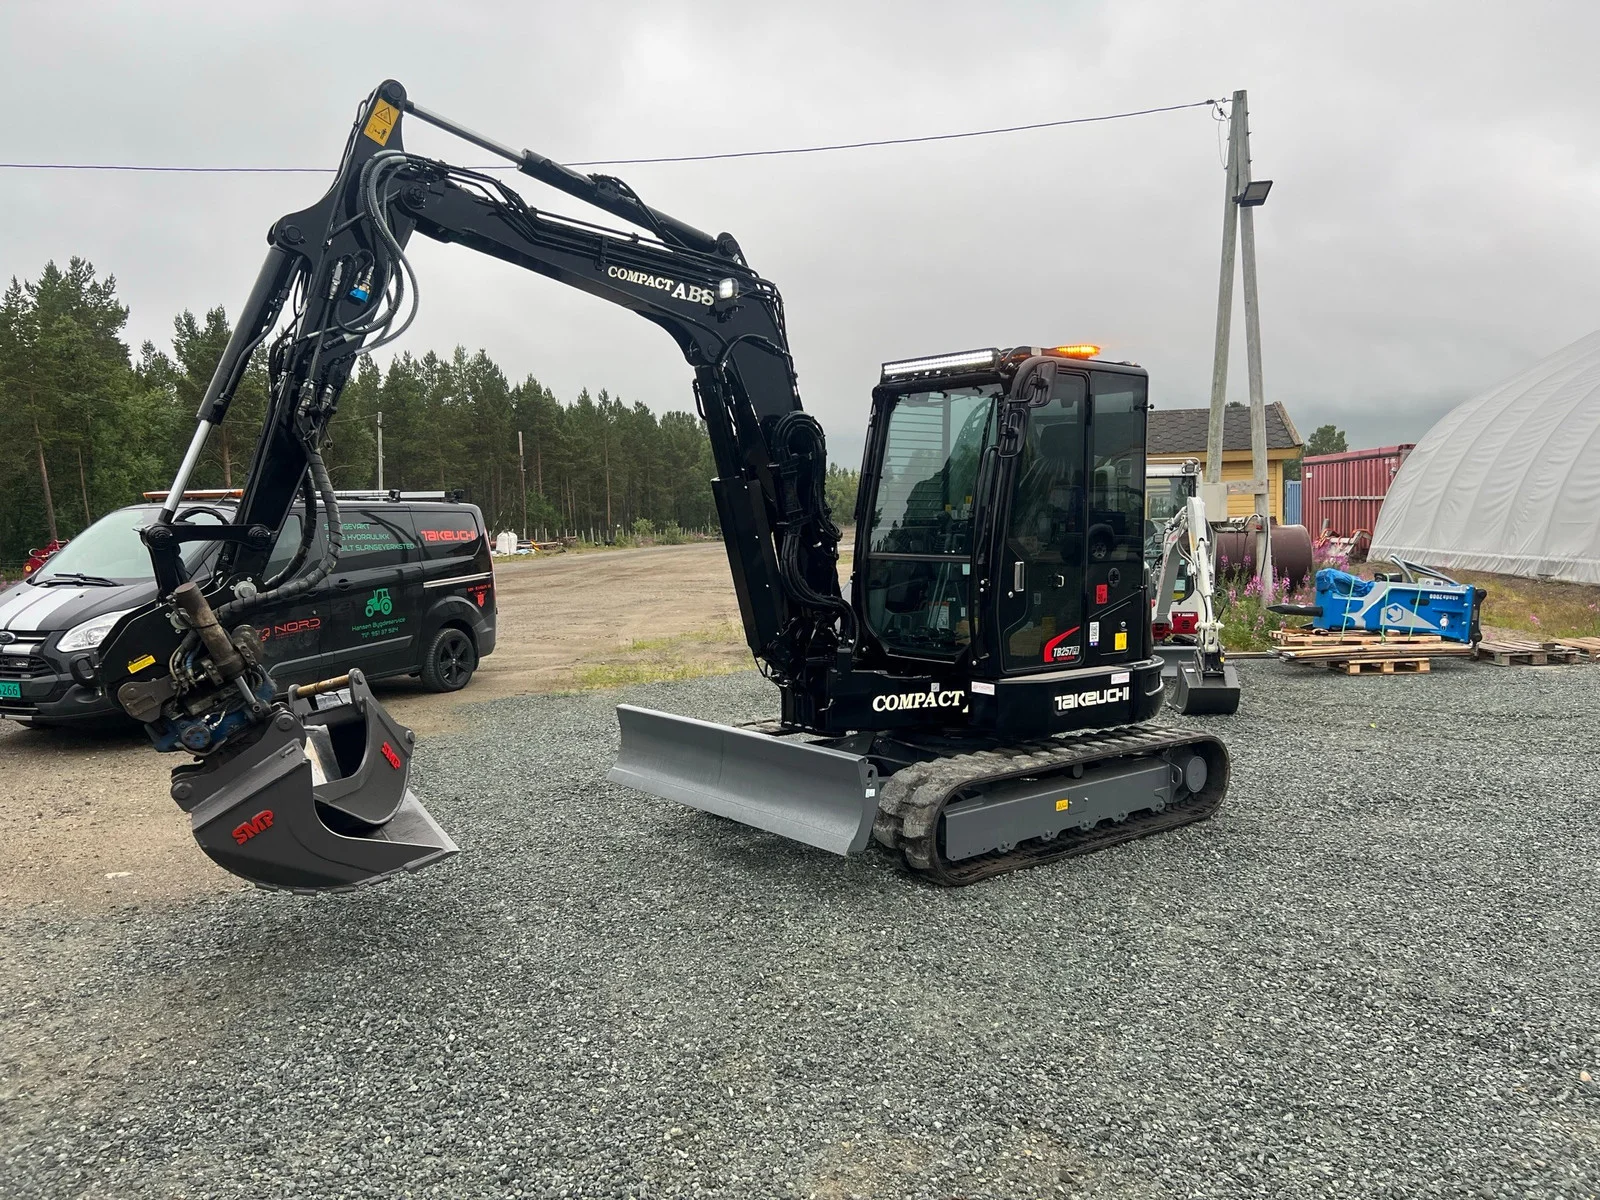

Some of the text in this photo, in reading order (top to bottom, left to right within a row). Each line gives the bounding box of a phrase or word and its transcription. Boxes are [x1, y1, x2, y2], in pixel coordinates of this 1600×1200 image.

[607, 265, 715, 306] COMPACT ABS
[421, 530, 476, 542] TAKEUCHI
[274, 618, 321, 634] NORD
[351, 617, 406, 631] Hansen Bygdeservice
[0, 684, 18, 696] 266
[872, 690, 965, 712] COMPACT
[1054, 686, 1130, 710] TAKEUCHI
[381, 741, 401, 770] SMP
[231, 809, 274, 845] SMP
